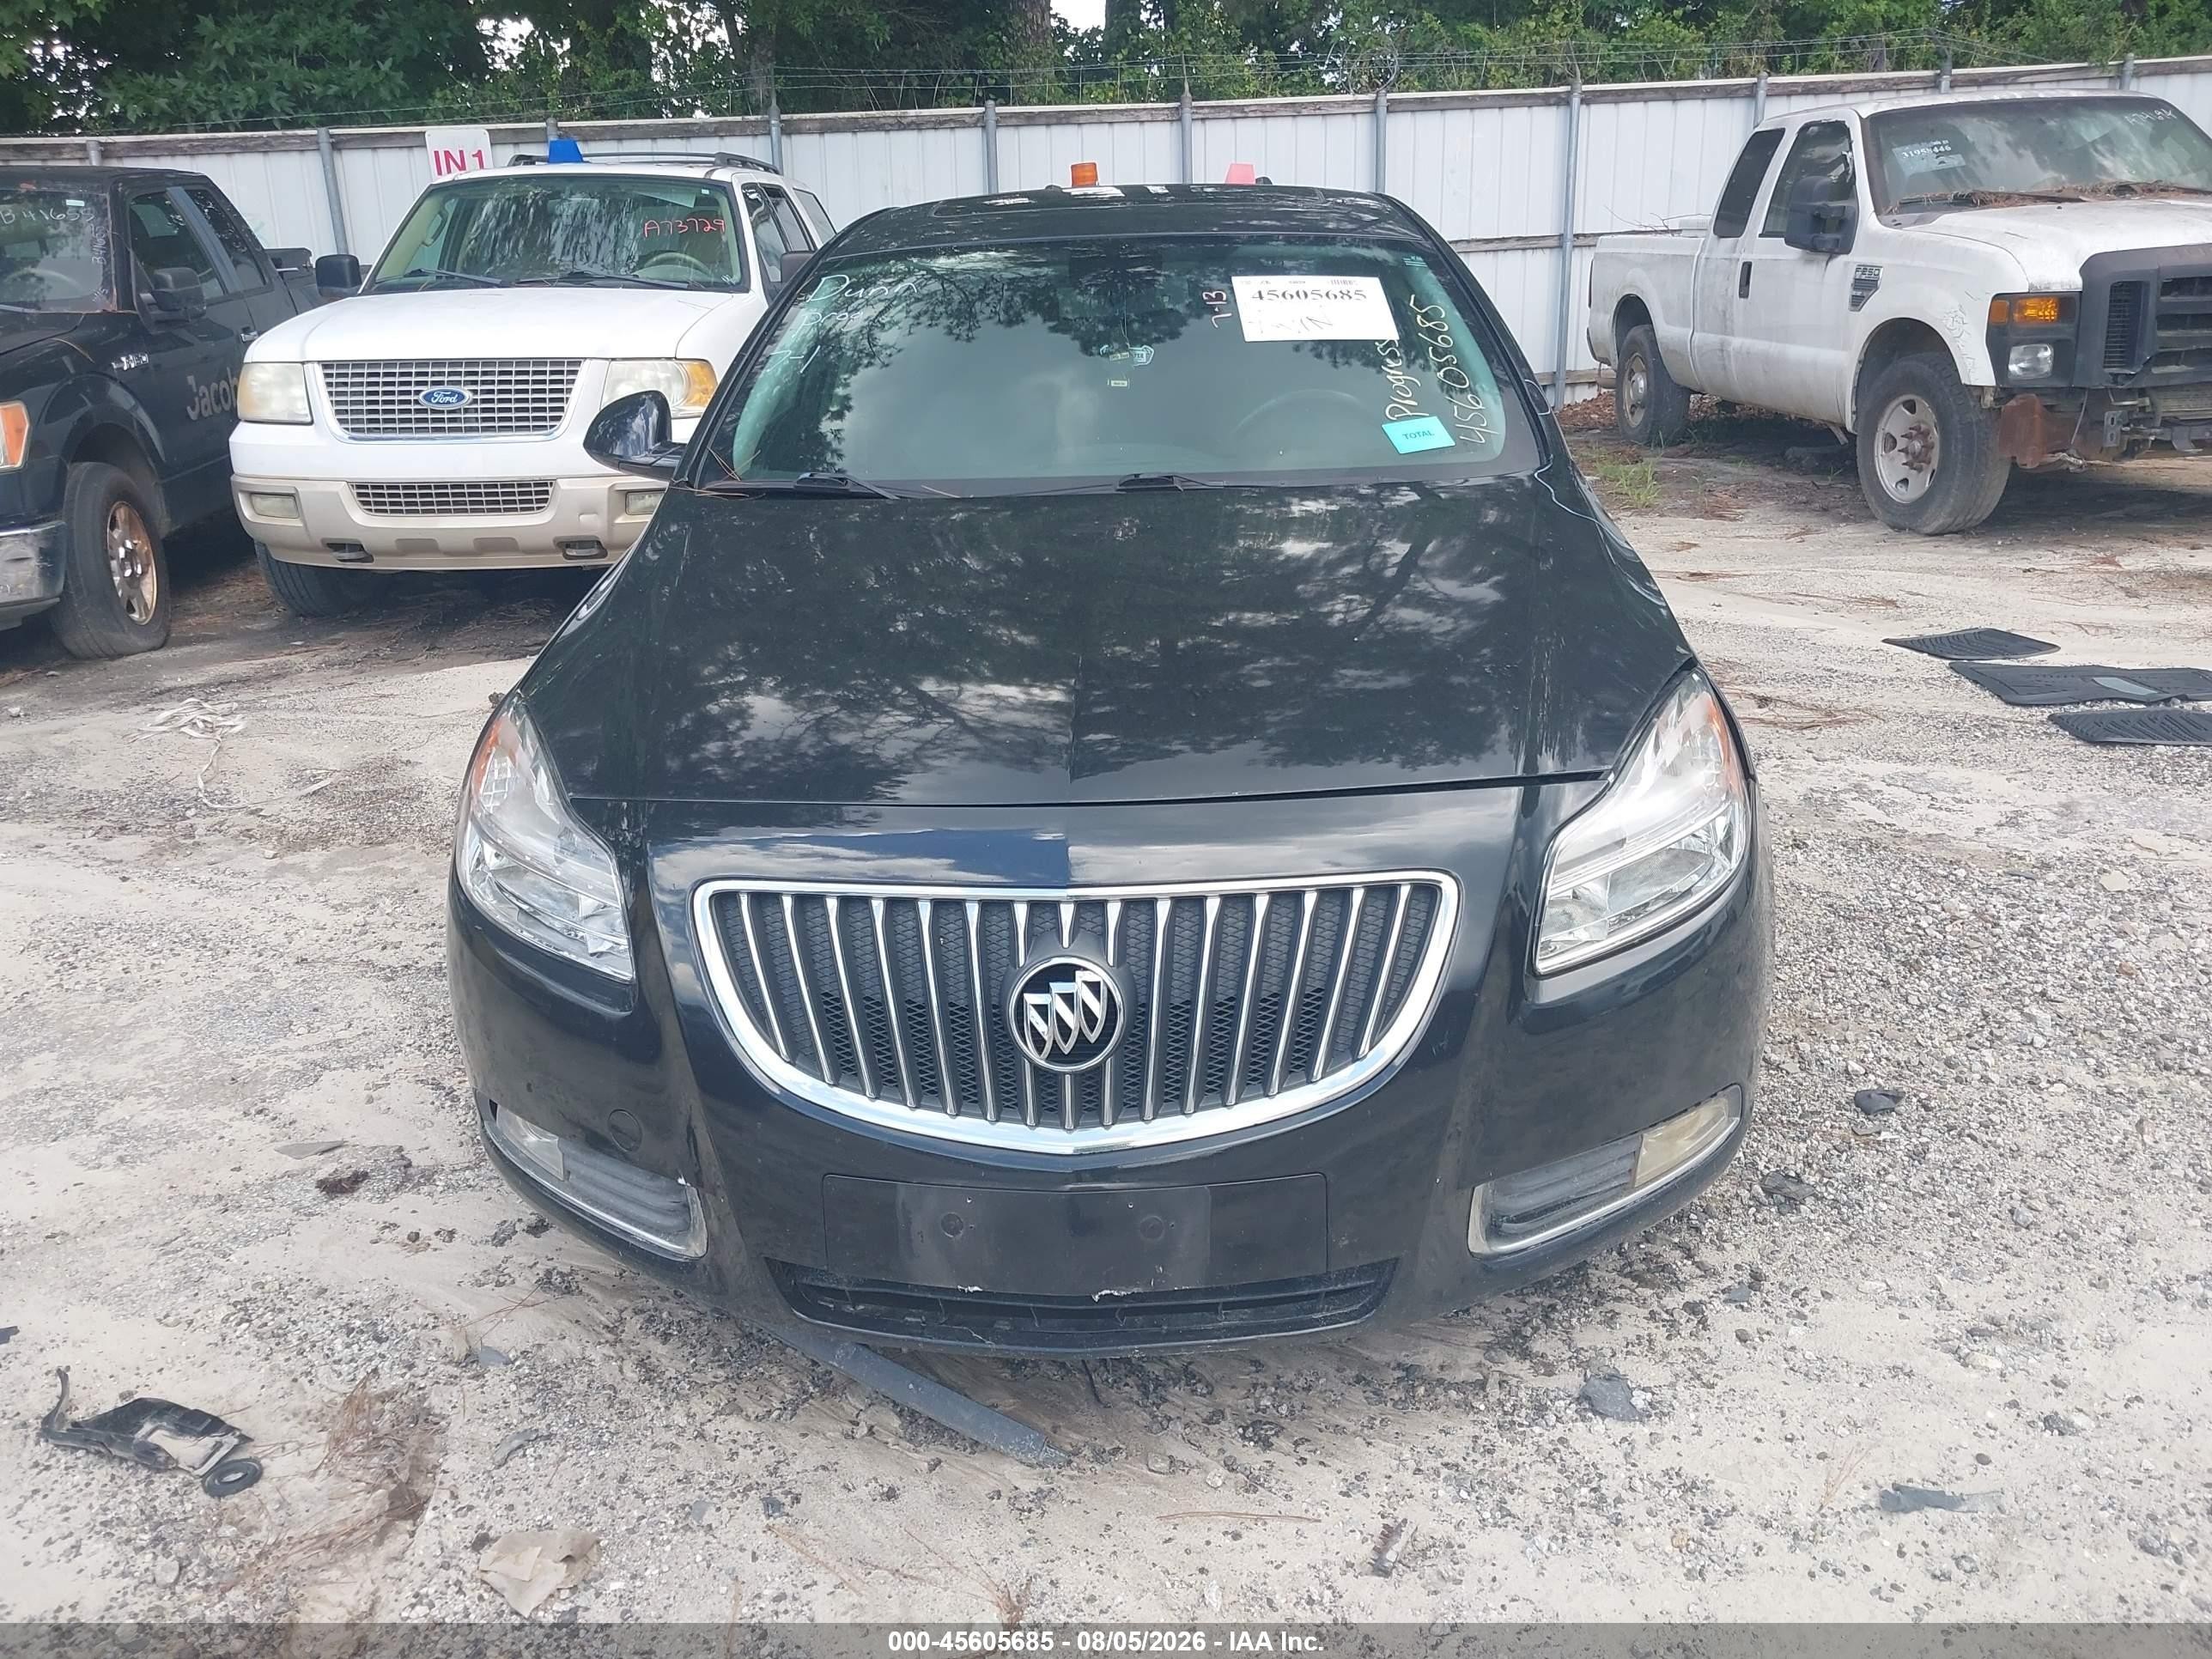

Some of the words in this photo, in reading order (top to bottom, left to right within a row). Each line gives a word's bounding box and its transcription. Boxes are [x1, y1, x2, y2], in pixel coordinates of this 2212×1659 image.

[433, 149, 467, 176] IN
[471, 149, 484, 170] 1
[644, 218, 726, 238] A73729
[1250, 289, 1367, 301] 45605685
[1409, 294, 1501, 443] 45605685
[431, 391, 459, 404] Ford
[1402, 429, 1435, 440] TOTAL
